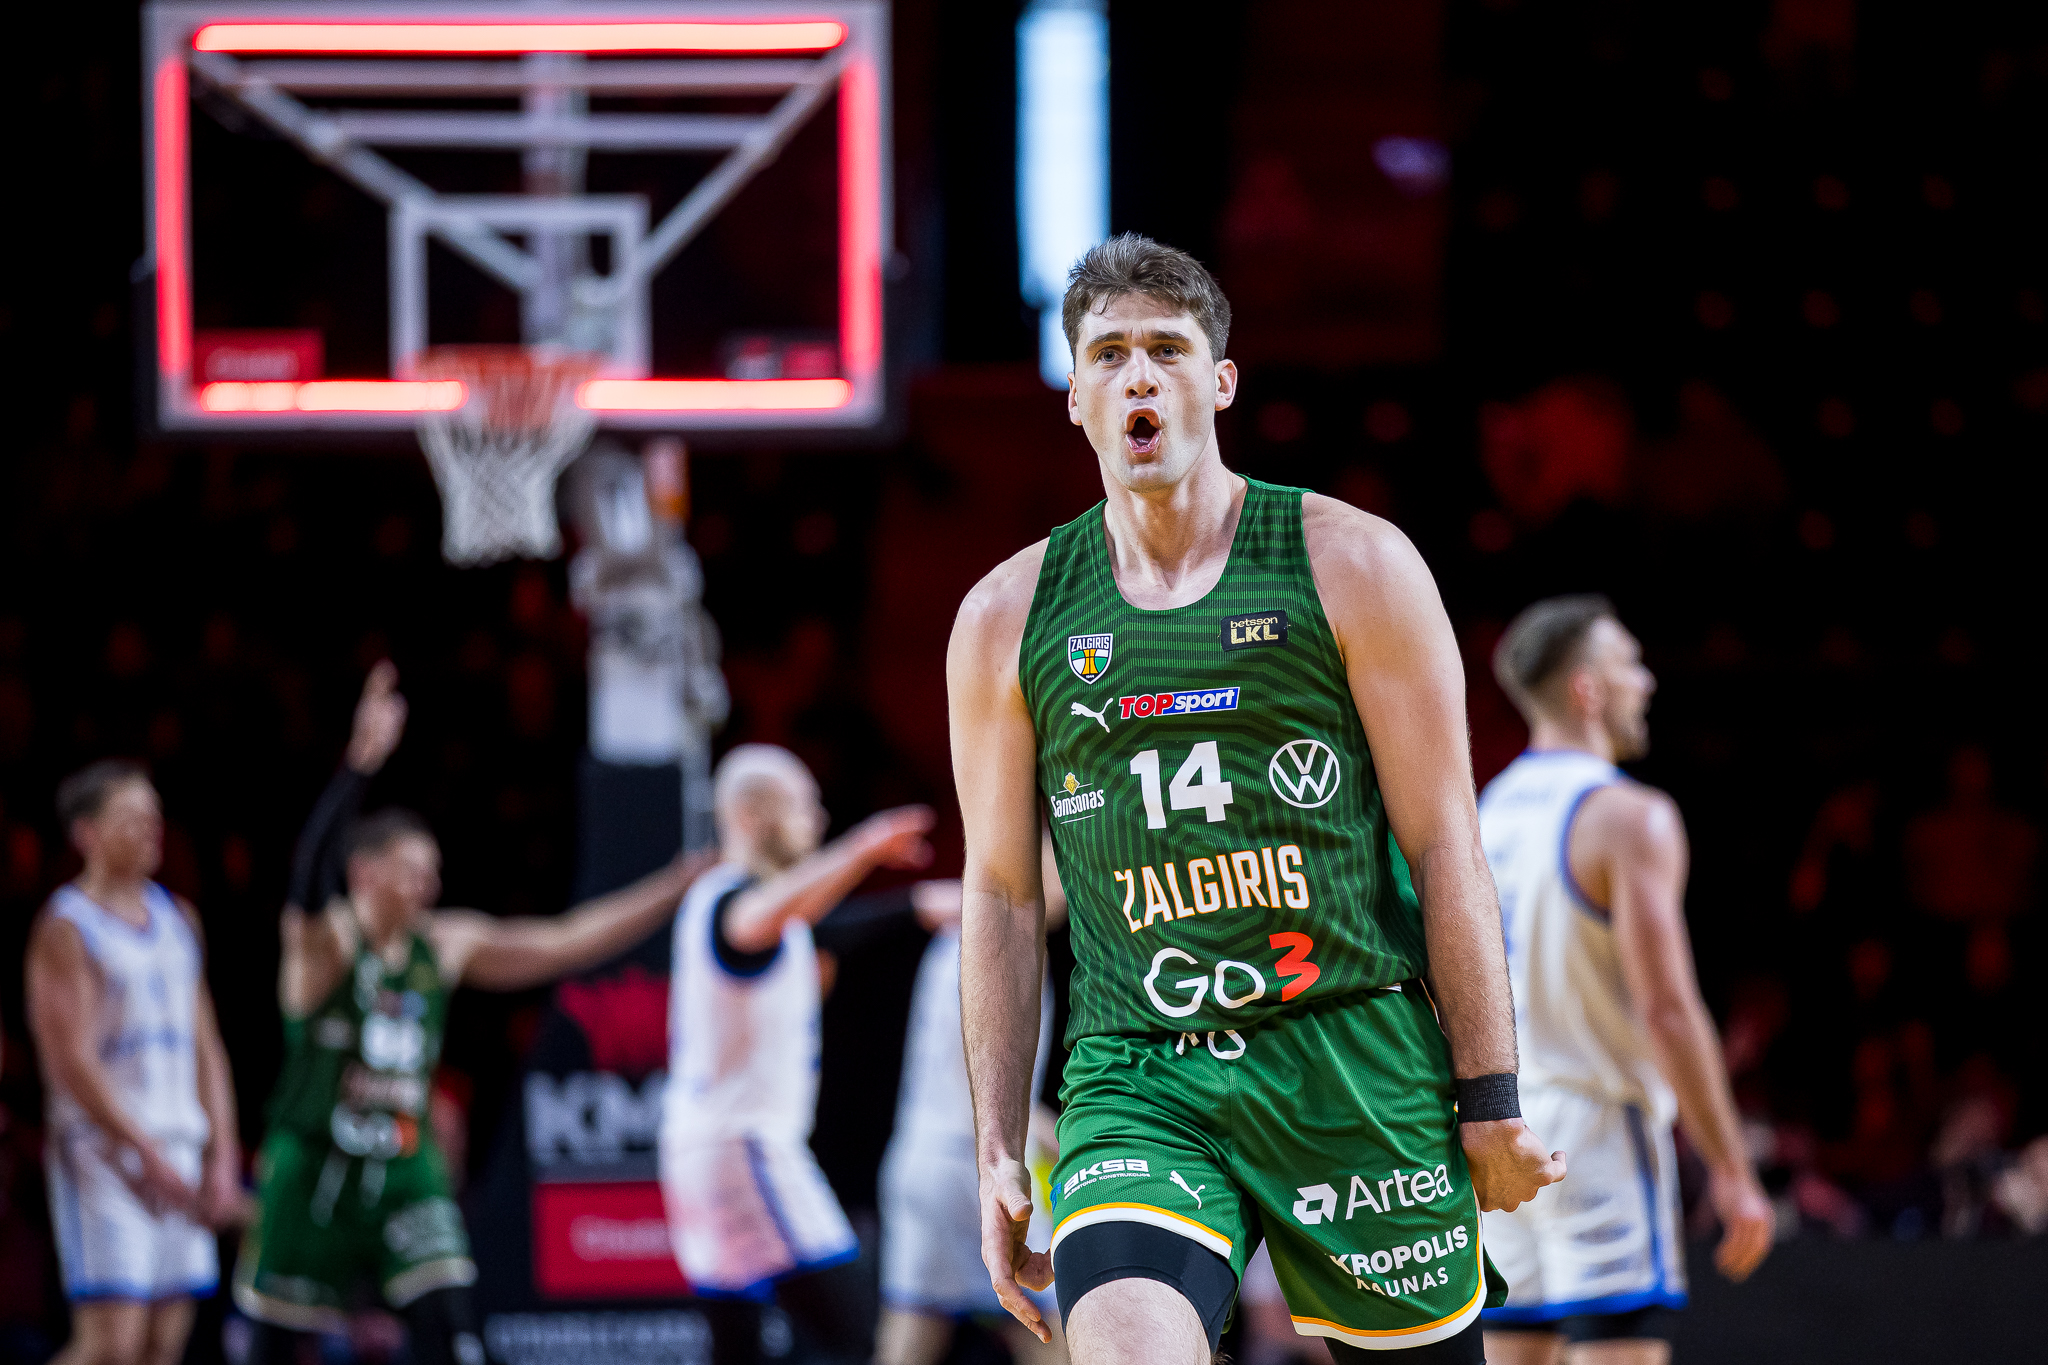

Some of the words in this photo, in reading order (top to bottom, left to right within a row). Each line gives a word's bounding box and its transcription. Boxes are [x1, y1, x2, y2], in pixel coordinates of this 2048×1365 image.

[1230, 616, 1278, 629] betsson
[1230, 624, 1279, 645] LKL
[1051, 788, 1105, 818] Samsonas
[1129, 740, 1234, 830] 14
[1345, 1163, 1454, 1221] Artea
[1328, 1224, 1469, 1276] KROPOLIS
